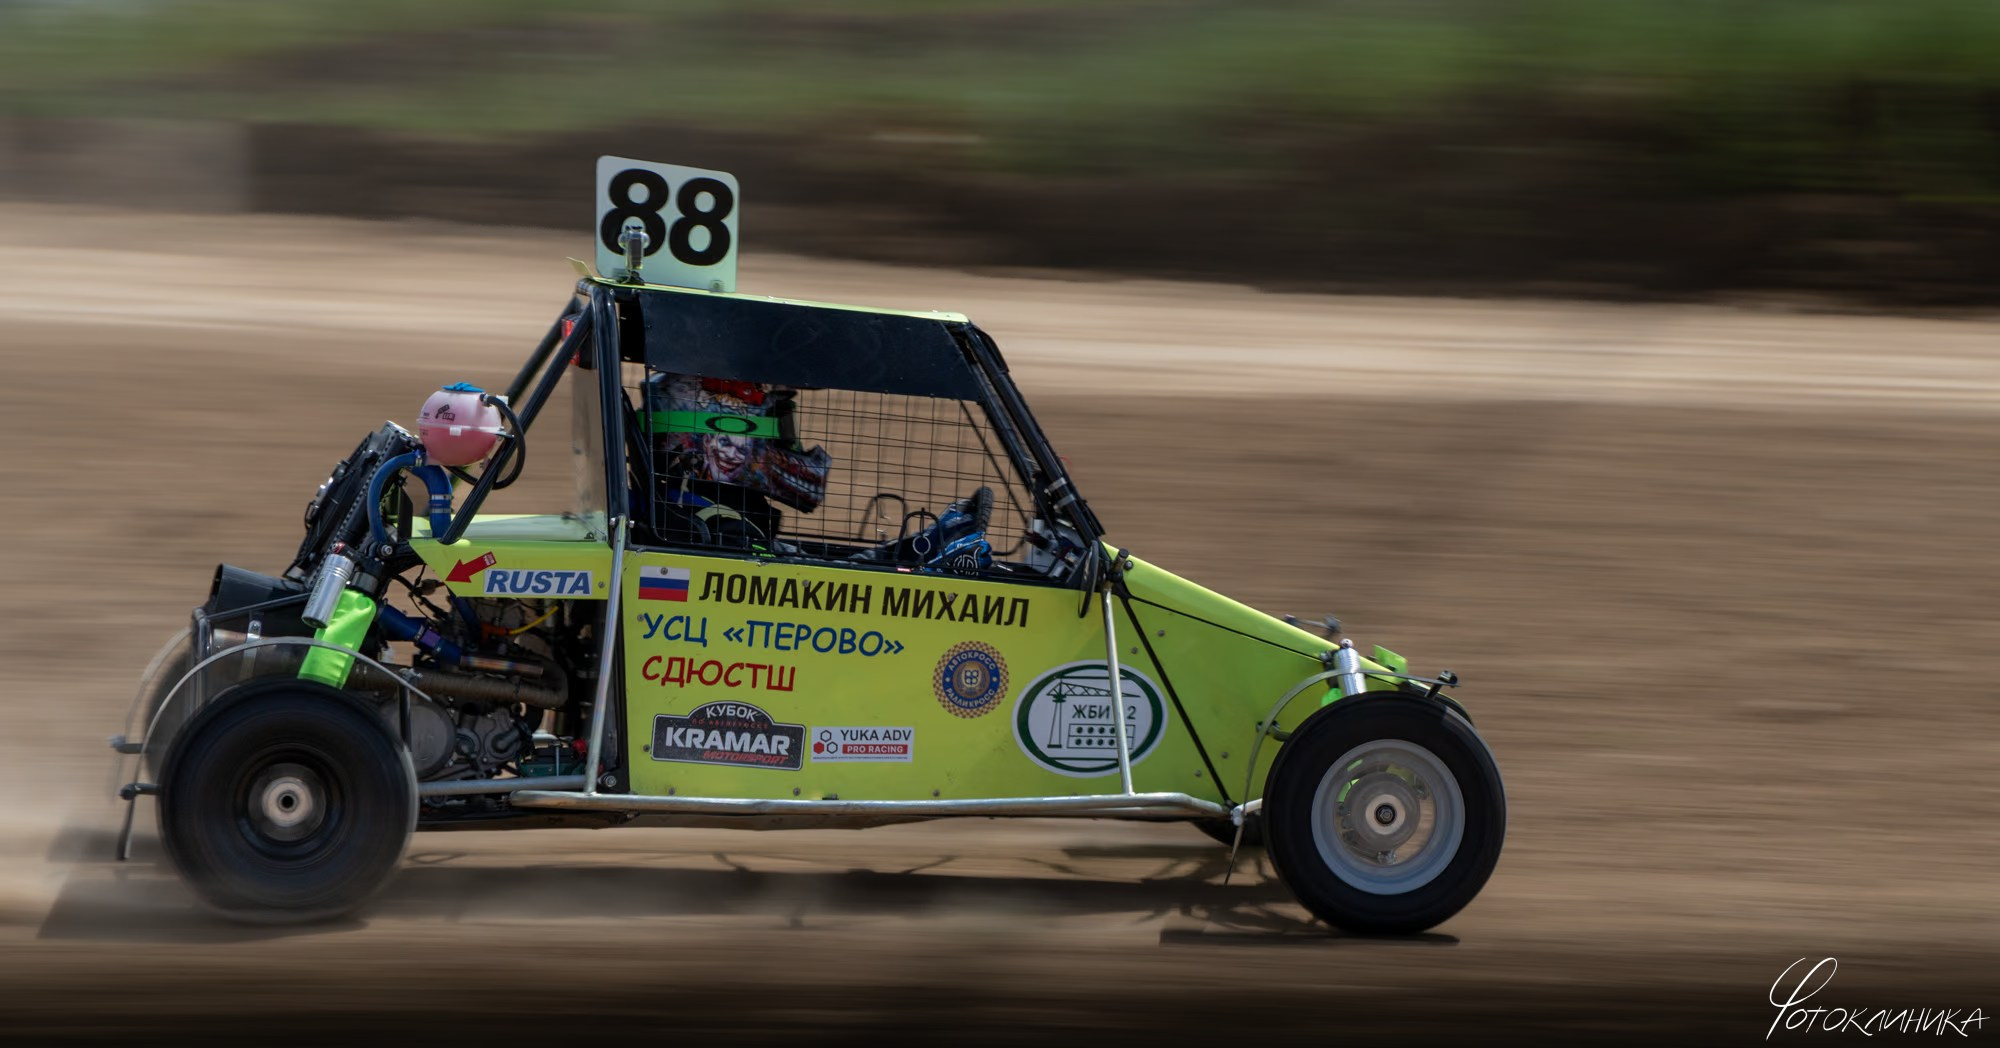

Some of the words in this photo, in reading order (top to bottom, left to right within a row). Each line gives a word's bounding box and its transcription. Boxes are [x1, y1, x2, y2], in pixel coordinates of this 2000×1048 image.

[601, 169, 733, 266] 88
[486, 570, 590, 594] RUSTA
[699, 572, 871, 614] ЛОМАКИН
[881, 586, 1029, 628] МИХАИЛ
[642, 613, 708, 647] УСЦ
[723, 620, 905, 657] «ПЕРОВО»
[948, 652, 996, 671] АВТОКРОСС
[641, 656, 796, 691] СДЮСТШ
[946, 688, 995, 706] РАЛЛИКРОСС
[706, 705, 757, 721] КУБОК
[1072, 704, 1111, 719] ЖБИ
[665, 726, 790, 755] KRAMAR
[840, 729, 879, 741] YUKA
[882, 729, 912, 741] ADV
[703, 752, 789, 764] MOTORSPORT
[847, 745, 865, 753] PRO
[868, 745, 904, 754] RACING
